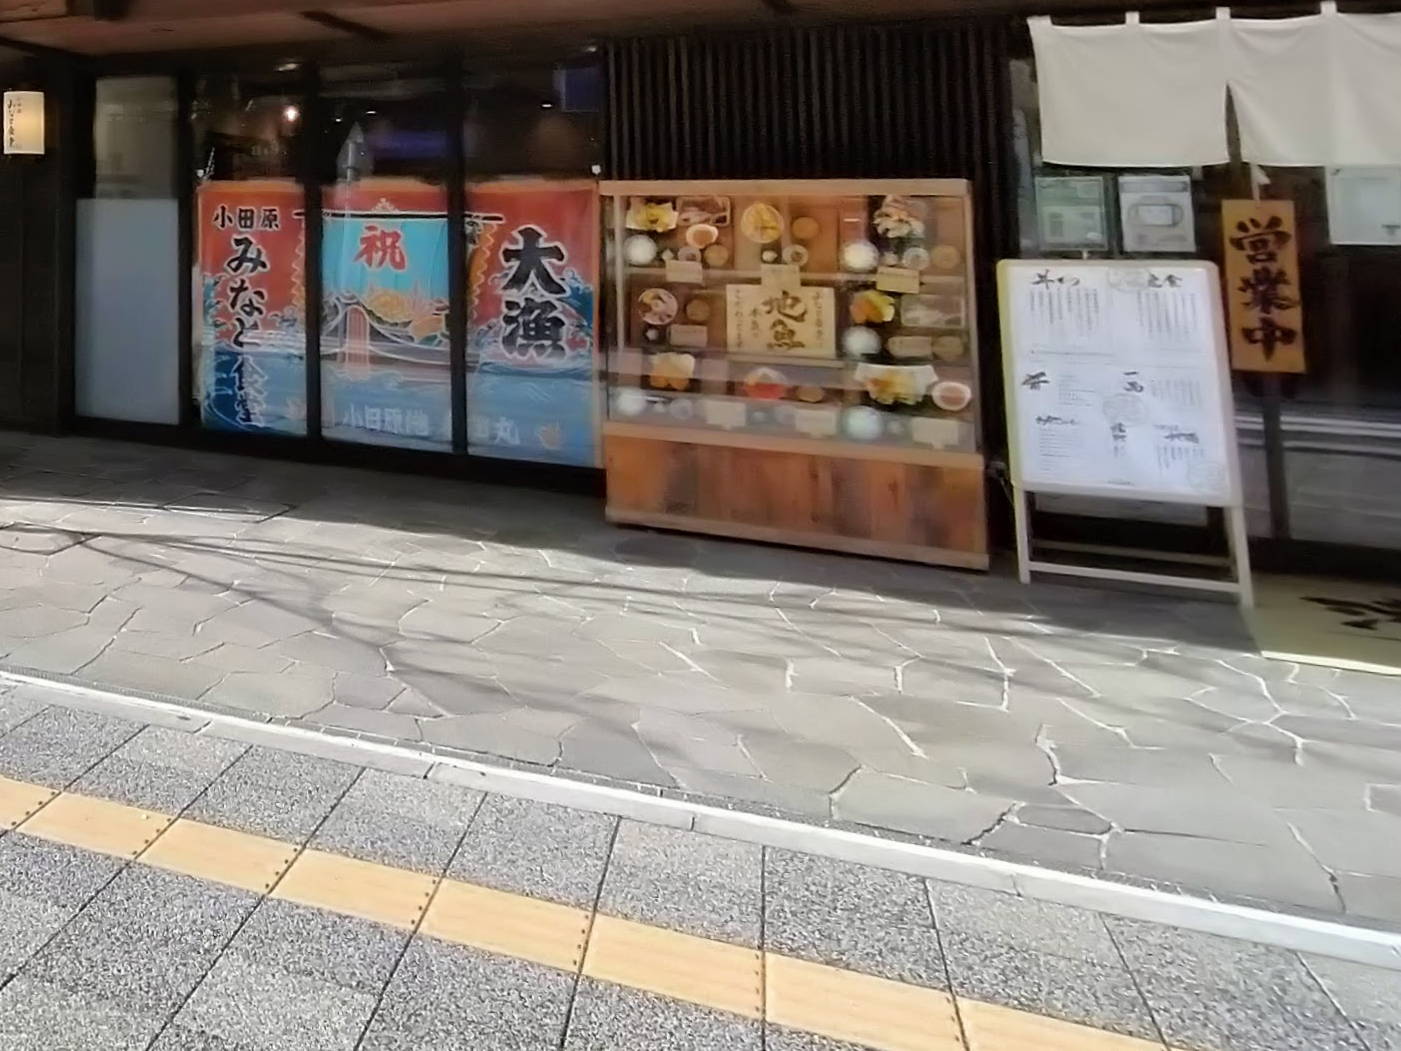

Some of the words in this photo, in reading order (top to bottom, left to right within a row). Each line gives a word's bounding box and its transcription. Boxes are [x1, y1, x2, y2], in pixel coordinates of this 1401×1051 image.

[214, 205, 280, 230] 小田原
[353, 225, 408, 271] 祝
[225, 236, 268, 429] みなと食堂
[501, 226, 568, 361] 大漁
[761, 290, 807, 349] 地魚
[1229, 215, 1297, 362] 営業中
